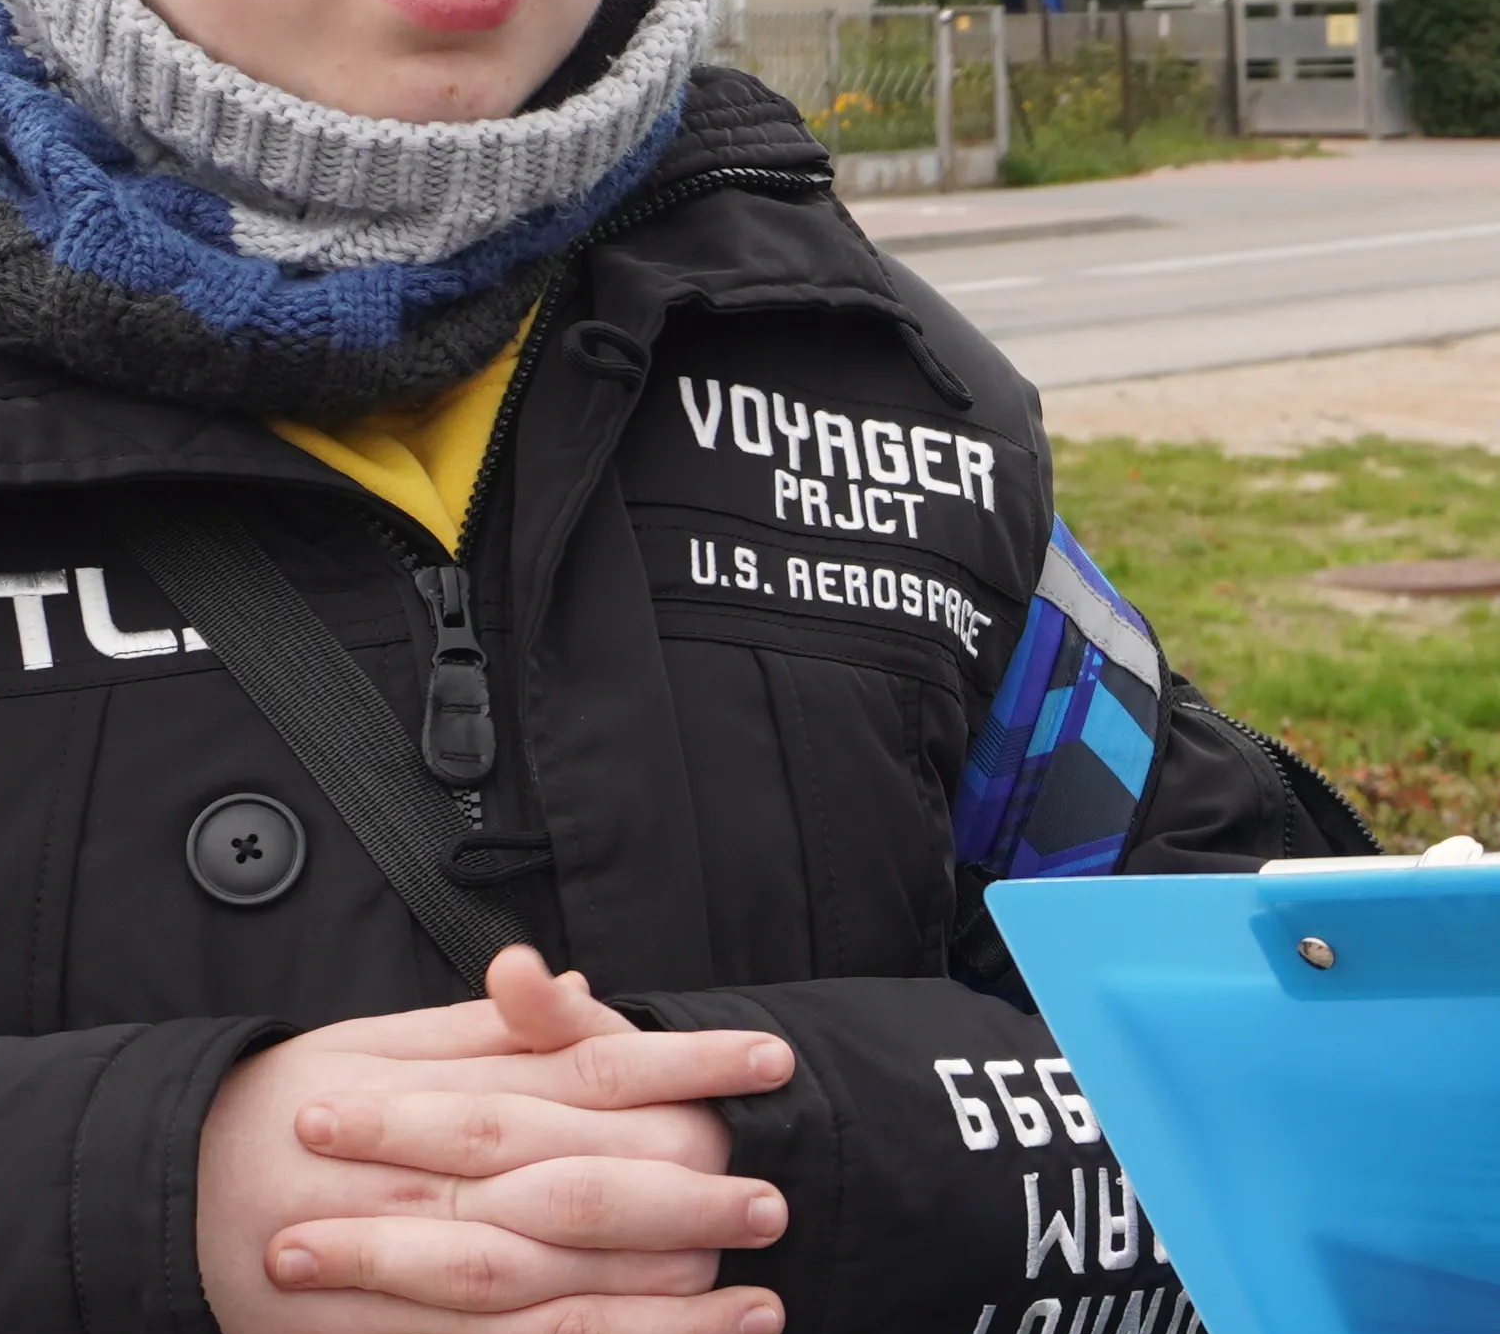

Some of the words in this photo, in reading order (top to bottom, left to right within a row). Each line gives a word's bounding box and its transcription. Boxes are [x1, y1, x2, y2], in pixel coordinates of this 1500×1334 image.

[678, 376, 996, 513] VOYAGER
[774, 469, 924, 539] PRJCT
[690, 538, 773, 595] U.S.
[787, 557, 993, 659] AEROSPACE
